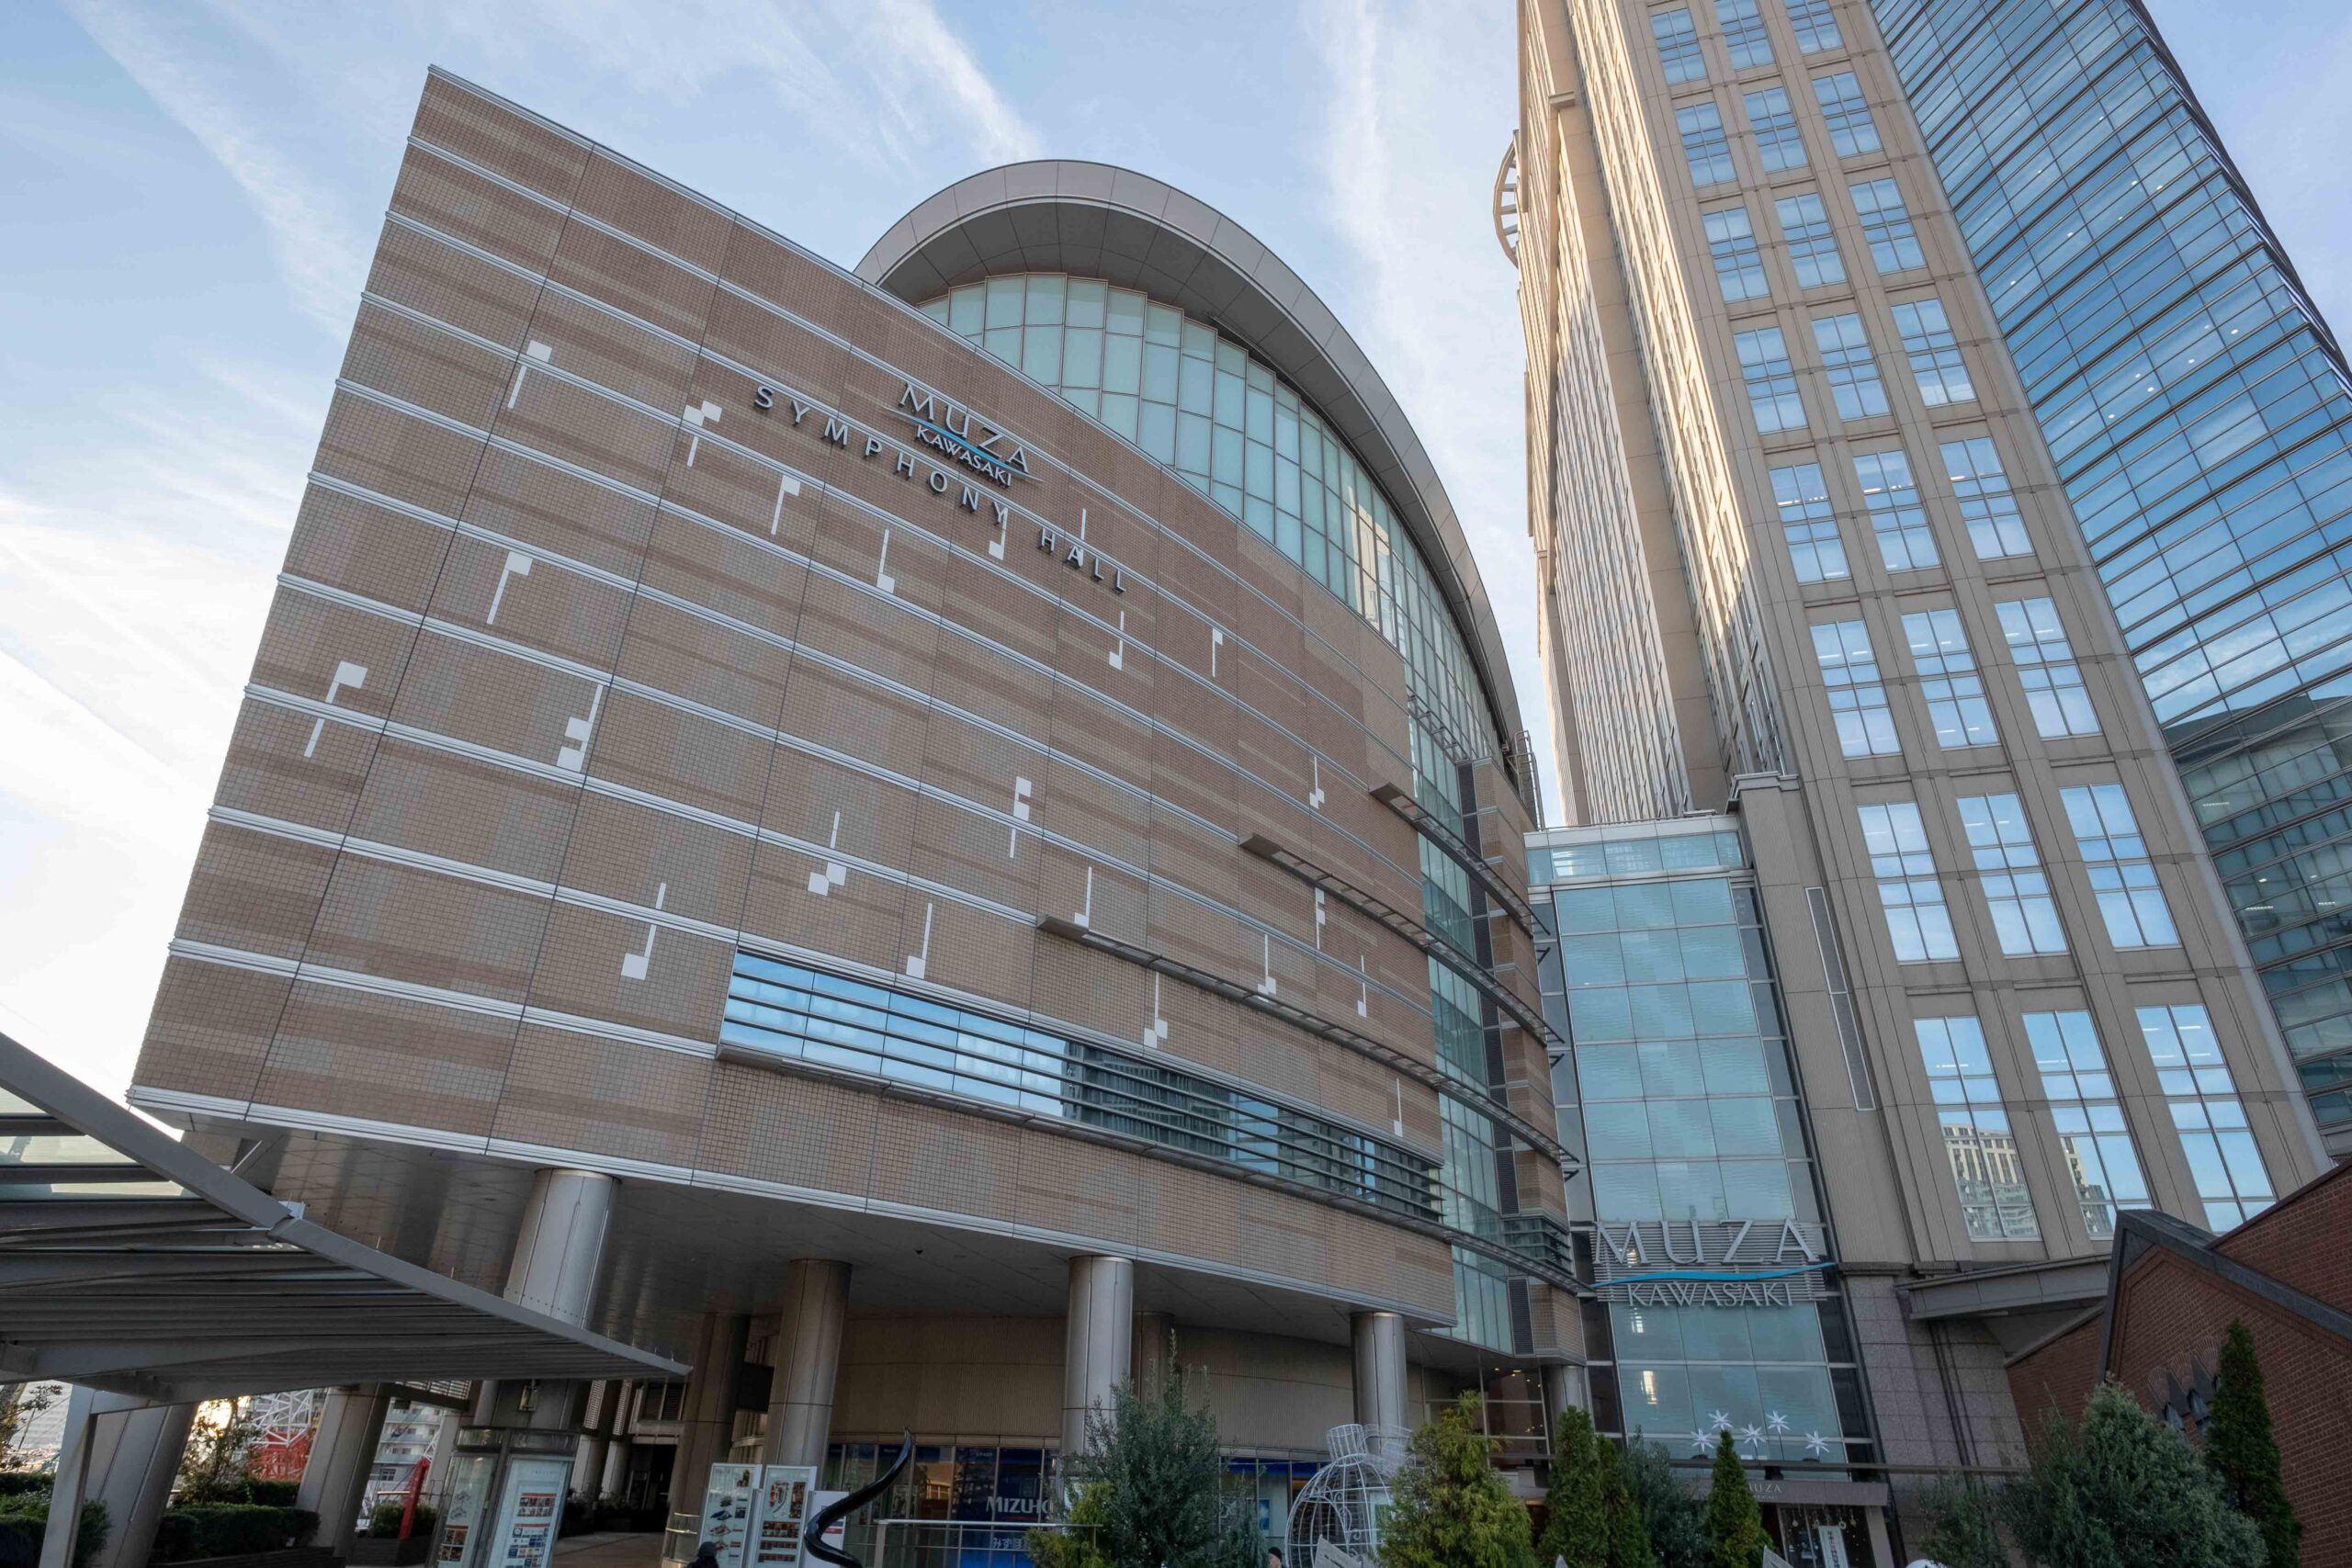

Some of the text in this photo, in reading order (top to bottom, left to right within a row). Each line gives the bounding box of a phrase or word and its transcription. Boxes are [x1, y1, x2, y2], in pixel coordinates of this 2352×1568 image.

[898, 381, 1030, 474] MUZA
[914, 424, 1012, 489] KAWASAKI
[753, 384, 1126, 594] SYMPHONY HALL
[1592, 1216, 1820, 1265] MUZA
[1626, 1281, 1792, 1307] KAWASAKI
